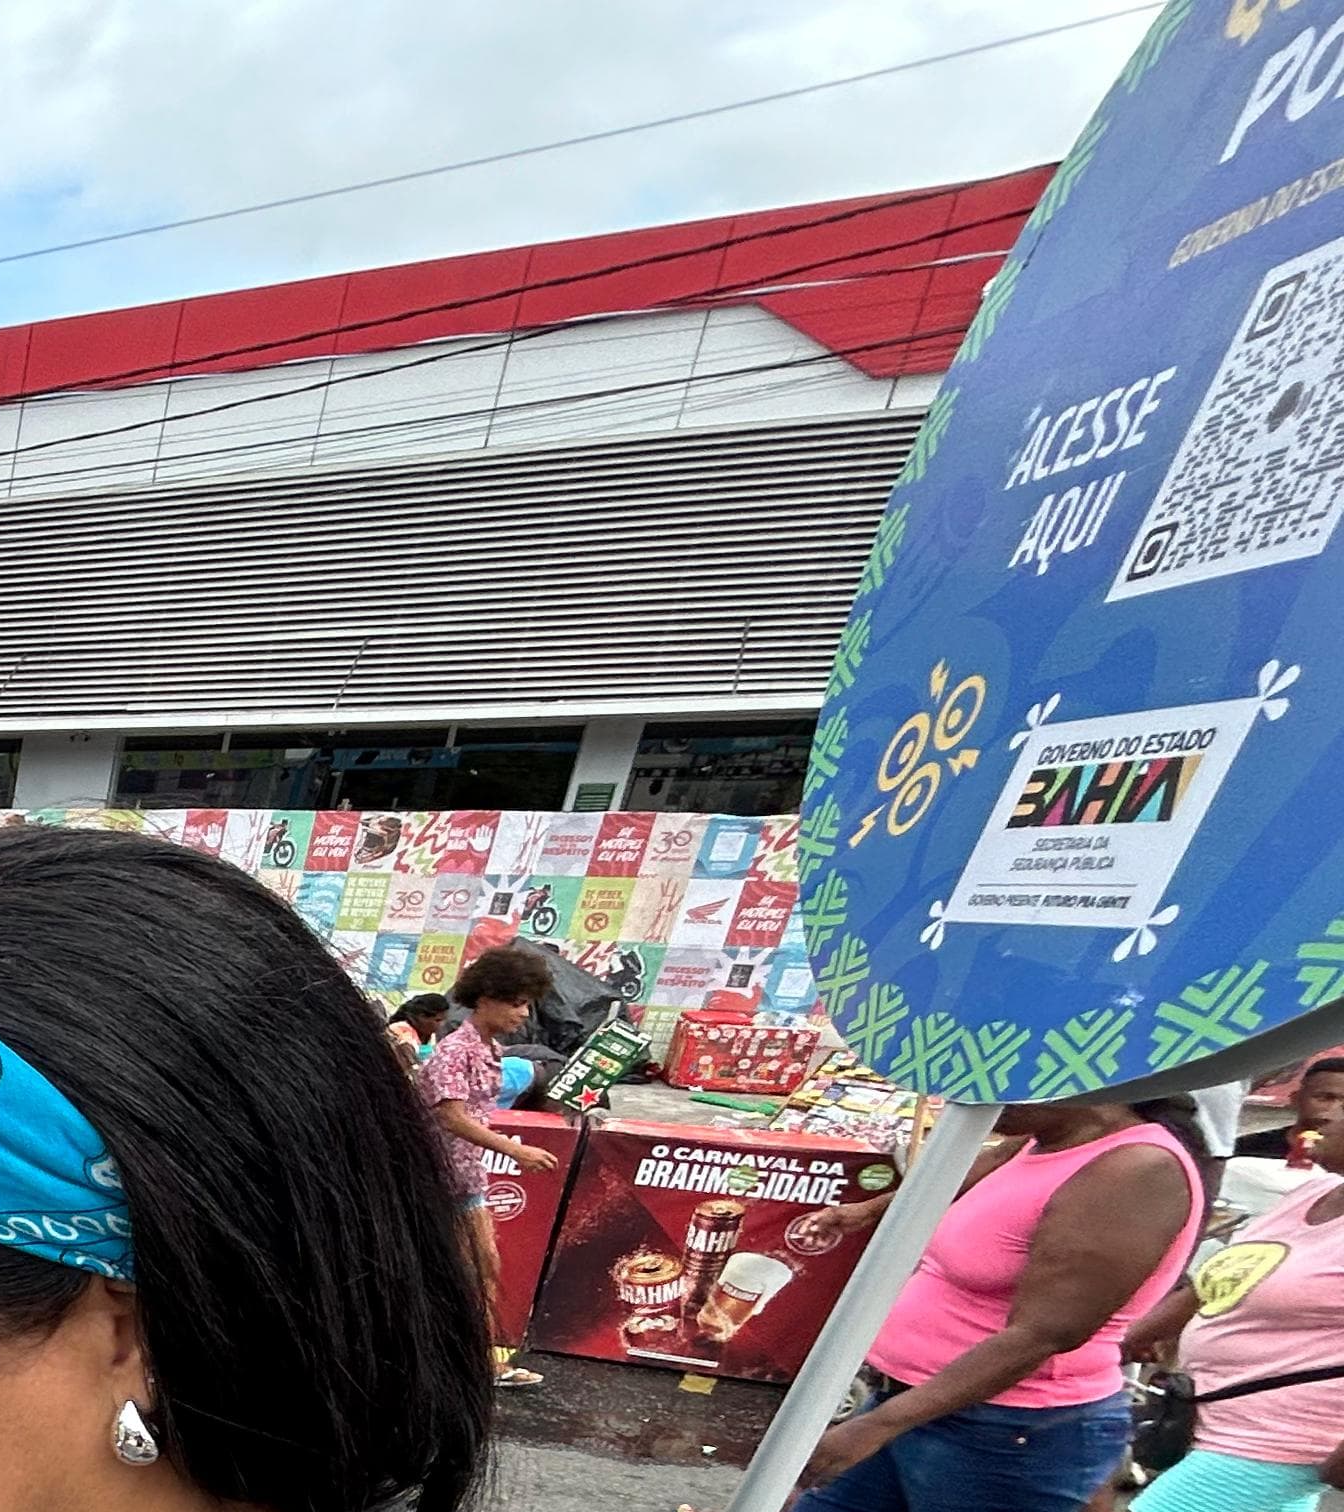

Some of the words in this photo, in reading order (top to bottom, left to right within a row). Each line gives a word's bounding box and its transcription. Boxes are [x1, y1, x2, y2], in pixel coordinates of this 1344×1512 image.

[1004, 365, 1178, 491] ACESSE
[1007, 470, 1126, 576] AQUI
[1037, 738, 1113, 766] GOVERNO
[1113, 735, 1141, 758] DO
[1144, 727, 1217, 755] ESTADO
[1004, 756, 1186, 831] BAHIA
[634, 1159, 849, 1207] BRAHMSIDADE
[651, 1145, 670, 1158] O
[673, 1147, 804, 1173] CARNAVAL
[809, 1161, 845, 1176] DA
